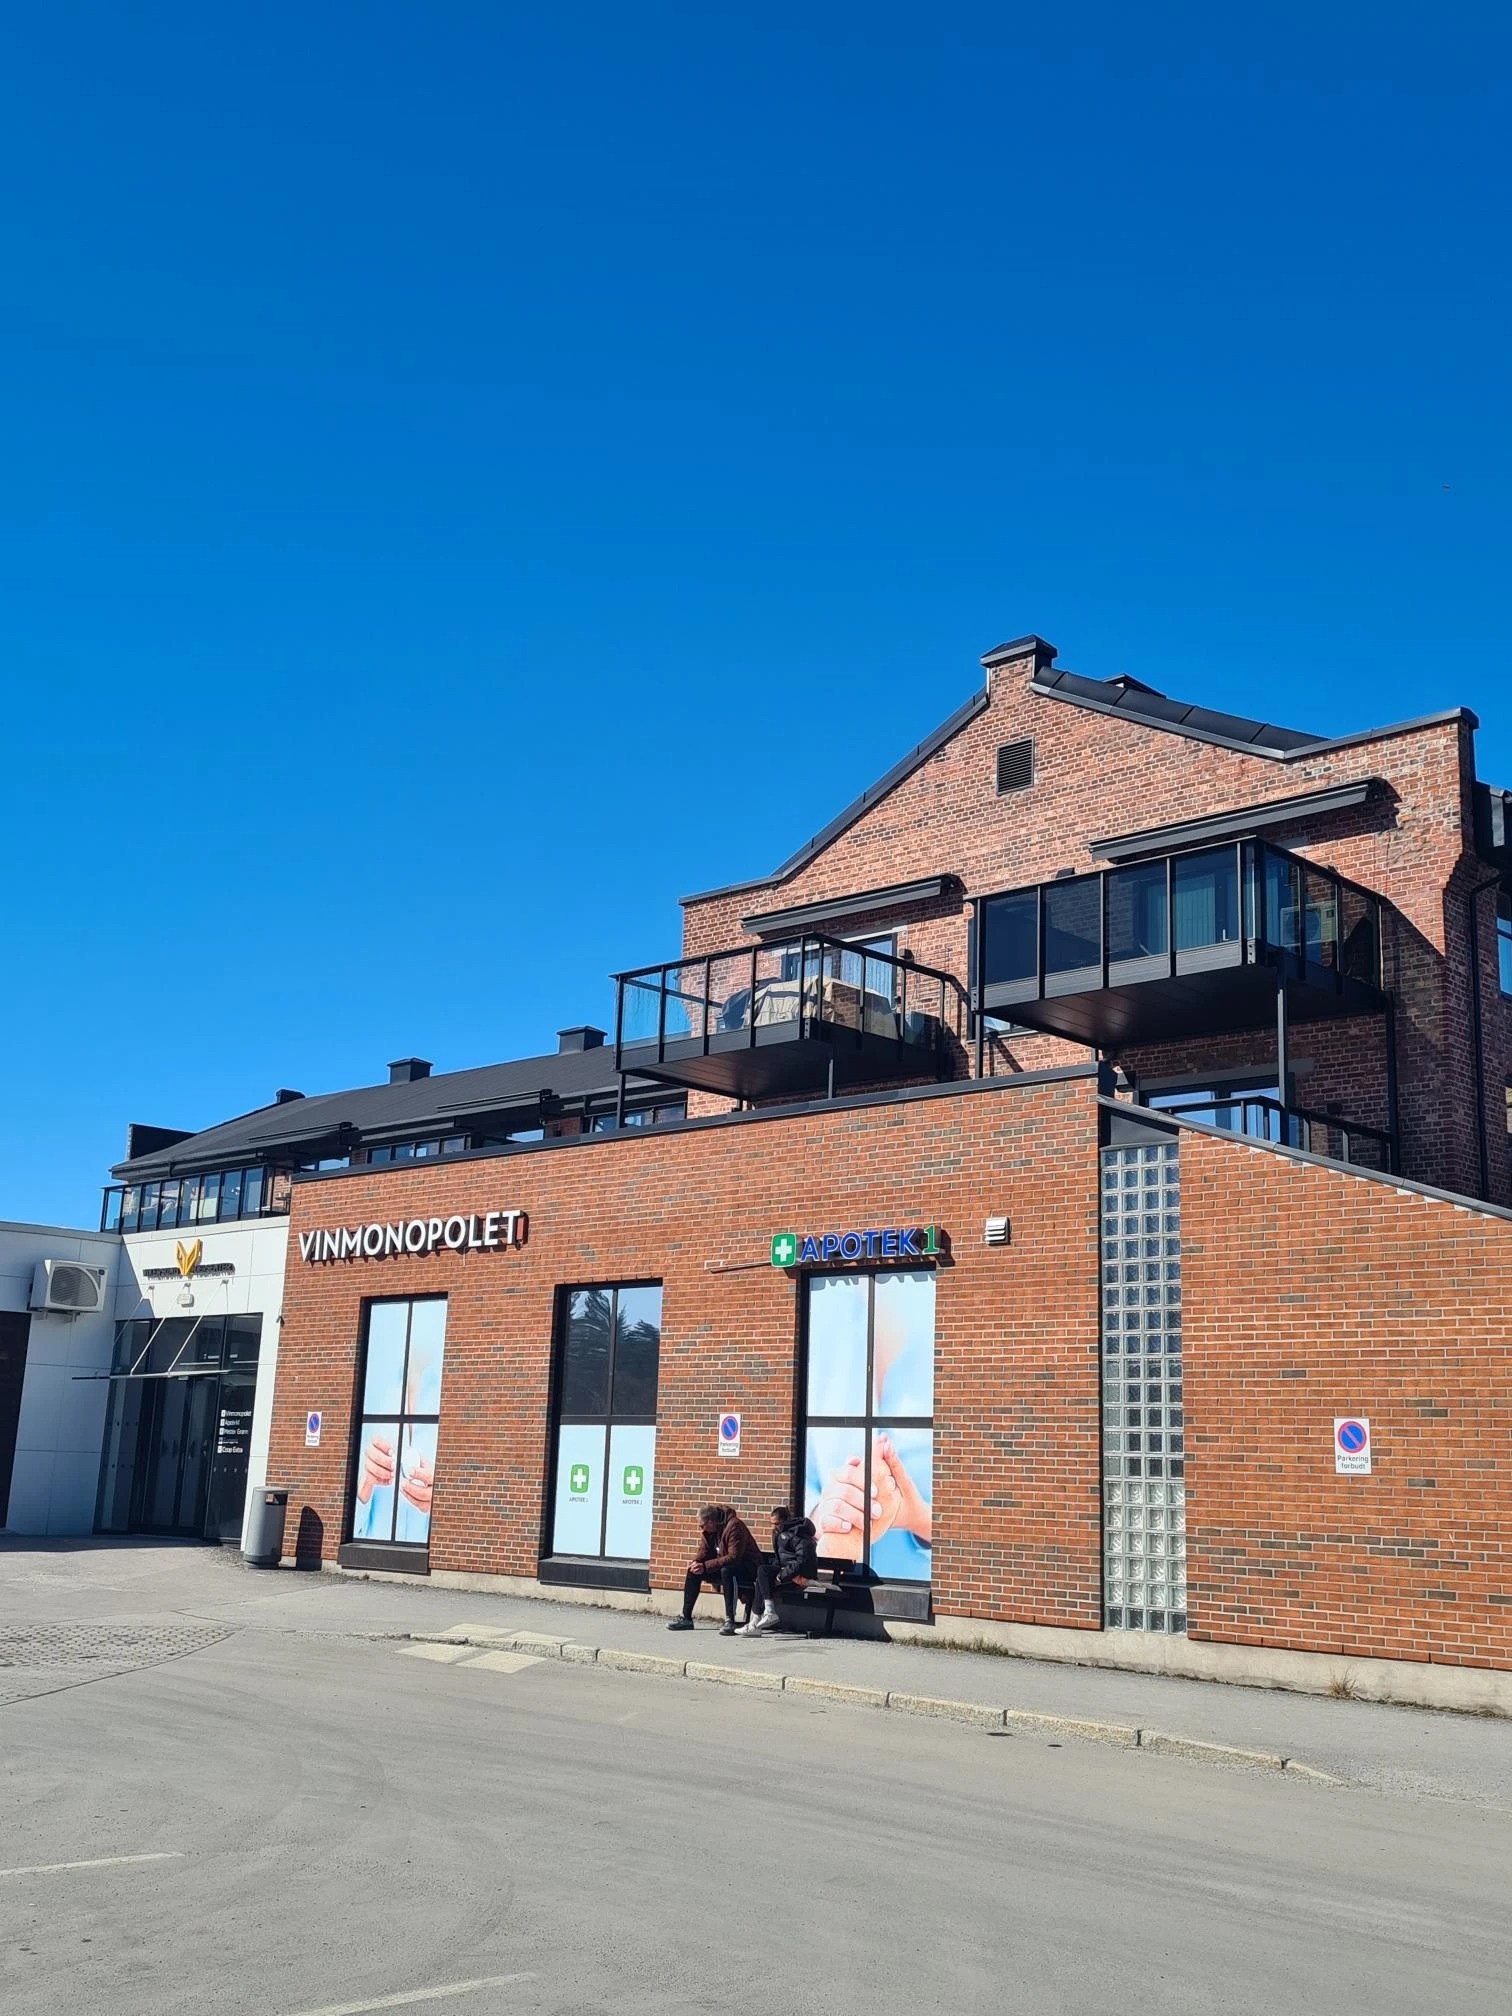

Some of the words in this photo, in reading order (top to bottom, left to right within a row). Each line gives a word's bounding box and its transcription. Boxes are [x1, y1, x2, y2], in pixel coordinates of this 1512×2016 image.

[299, 1210, 523, 1262] VINMONOPOLET
[800, 1227, 919, 1262] APOTEK
[922, 1225, 939, 1255] 1
[1337, 1454, 1369, 1464] Parkering
[1341, 1462, 1366, 1470] forbudt
